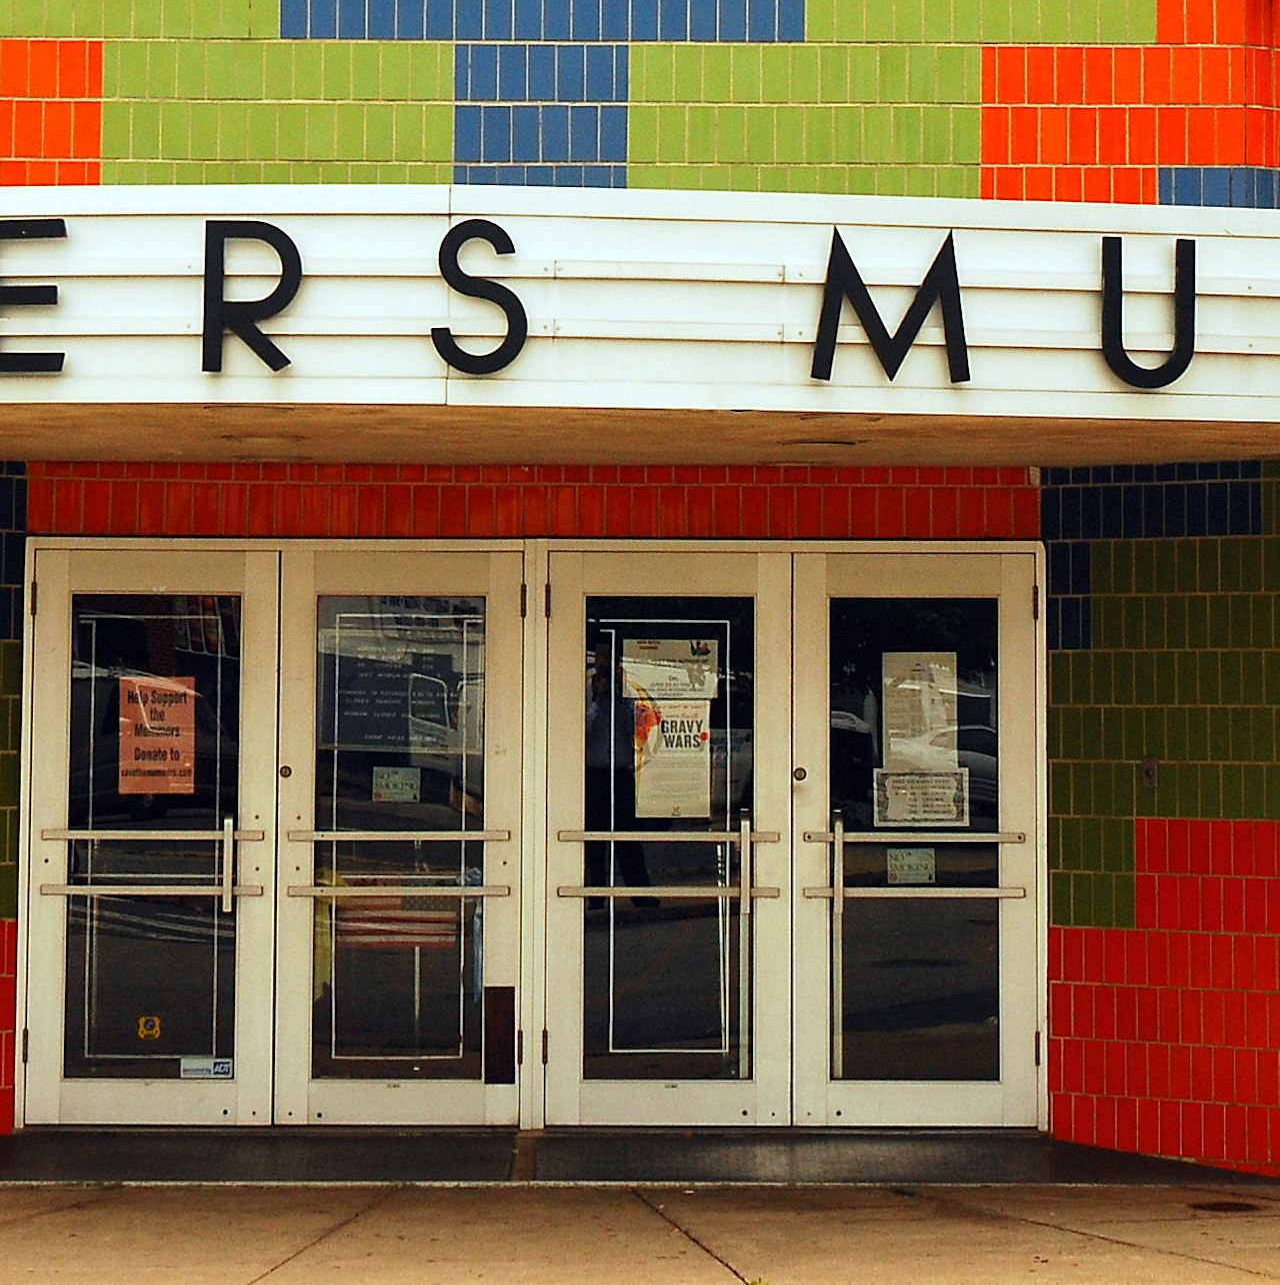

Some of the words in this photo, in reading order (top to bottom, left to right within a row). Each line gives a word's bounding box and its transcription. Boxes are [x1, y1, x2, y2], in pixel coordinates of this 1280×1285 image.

[127, 690, 148, 707] Help
[151, 690, 188, 707] Support
[149, 707, 165, 721] the
[134, 723, 181, 737] Mummers
[661, 719, 703, 733] GRAVY
[663, 734, 701, 748] WARS
[134, 747, 168, 761] Donate
[170, 747, 180, 761] to
[214, 1063, 230, 1074] ADT
